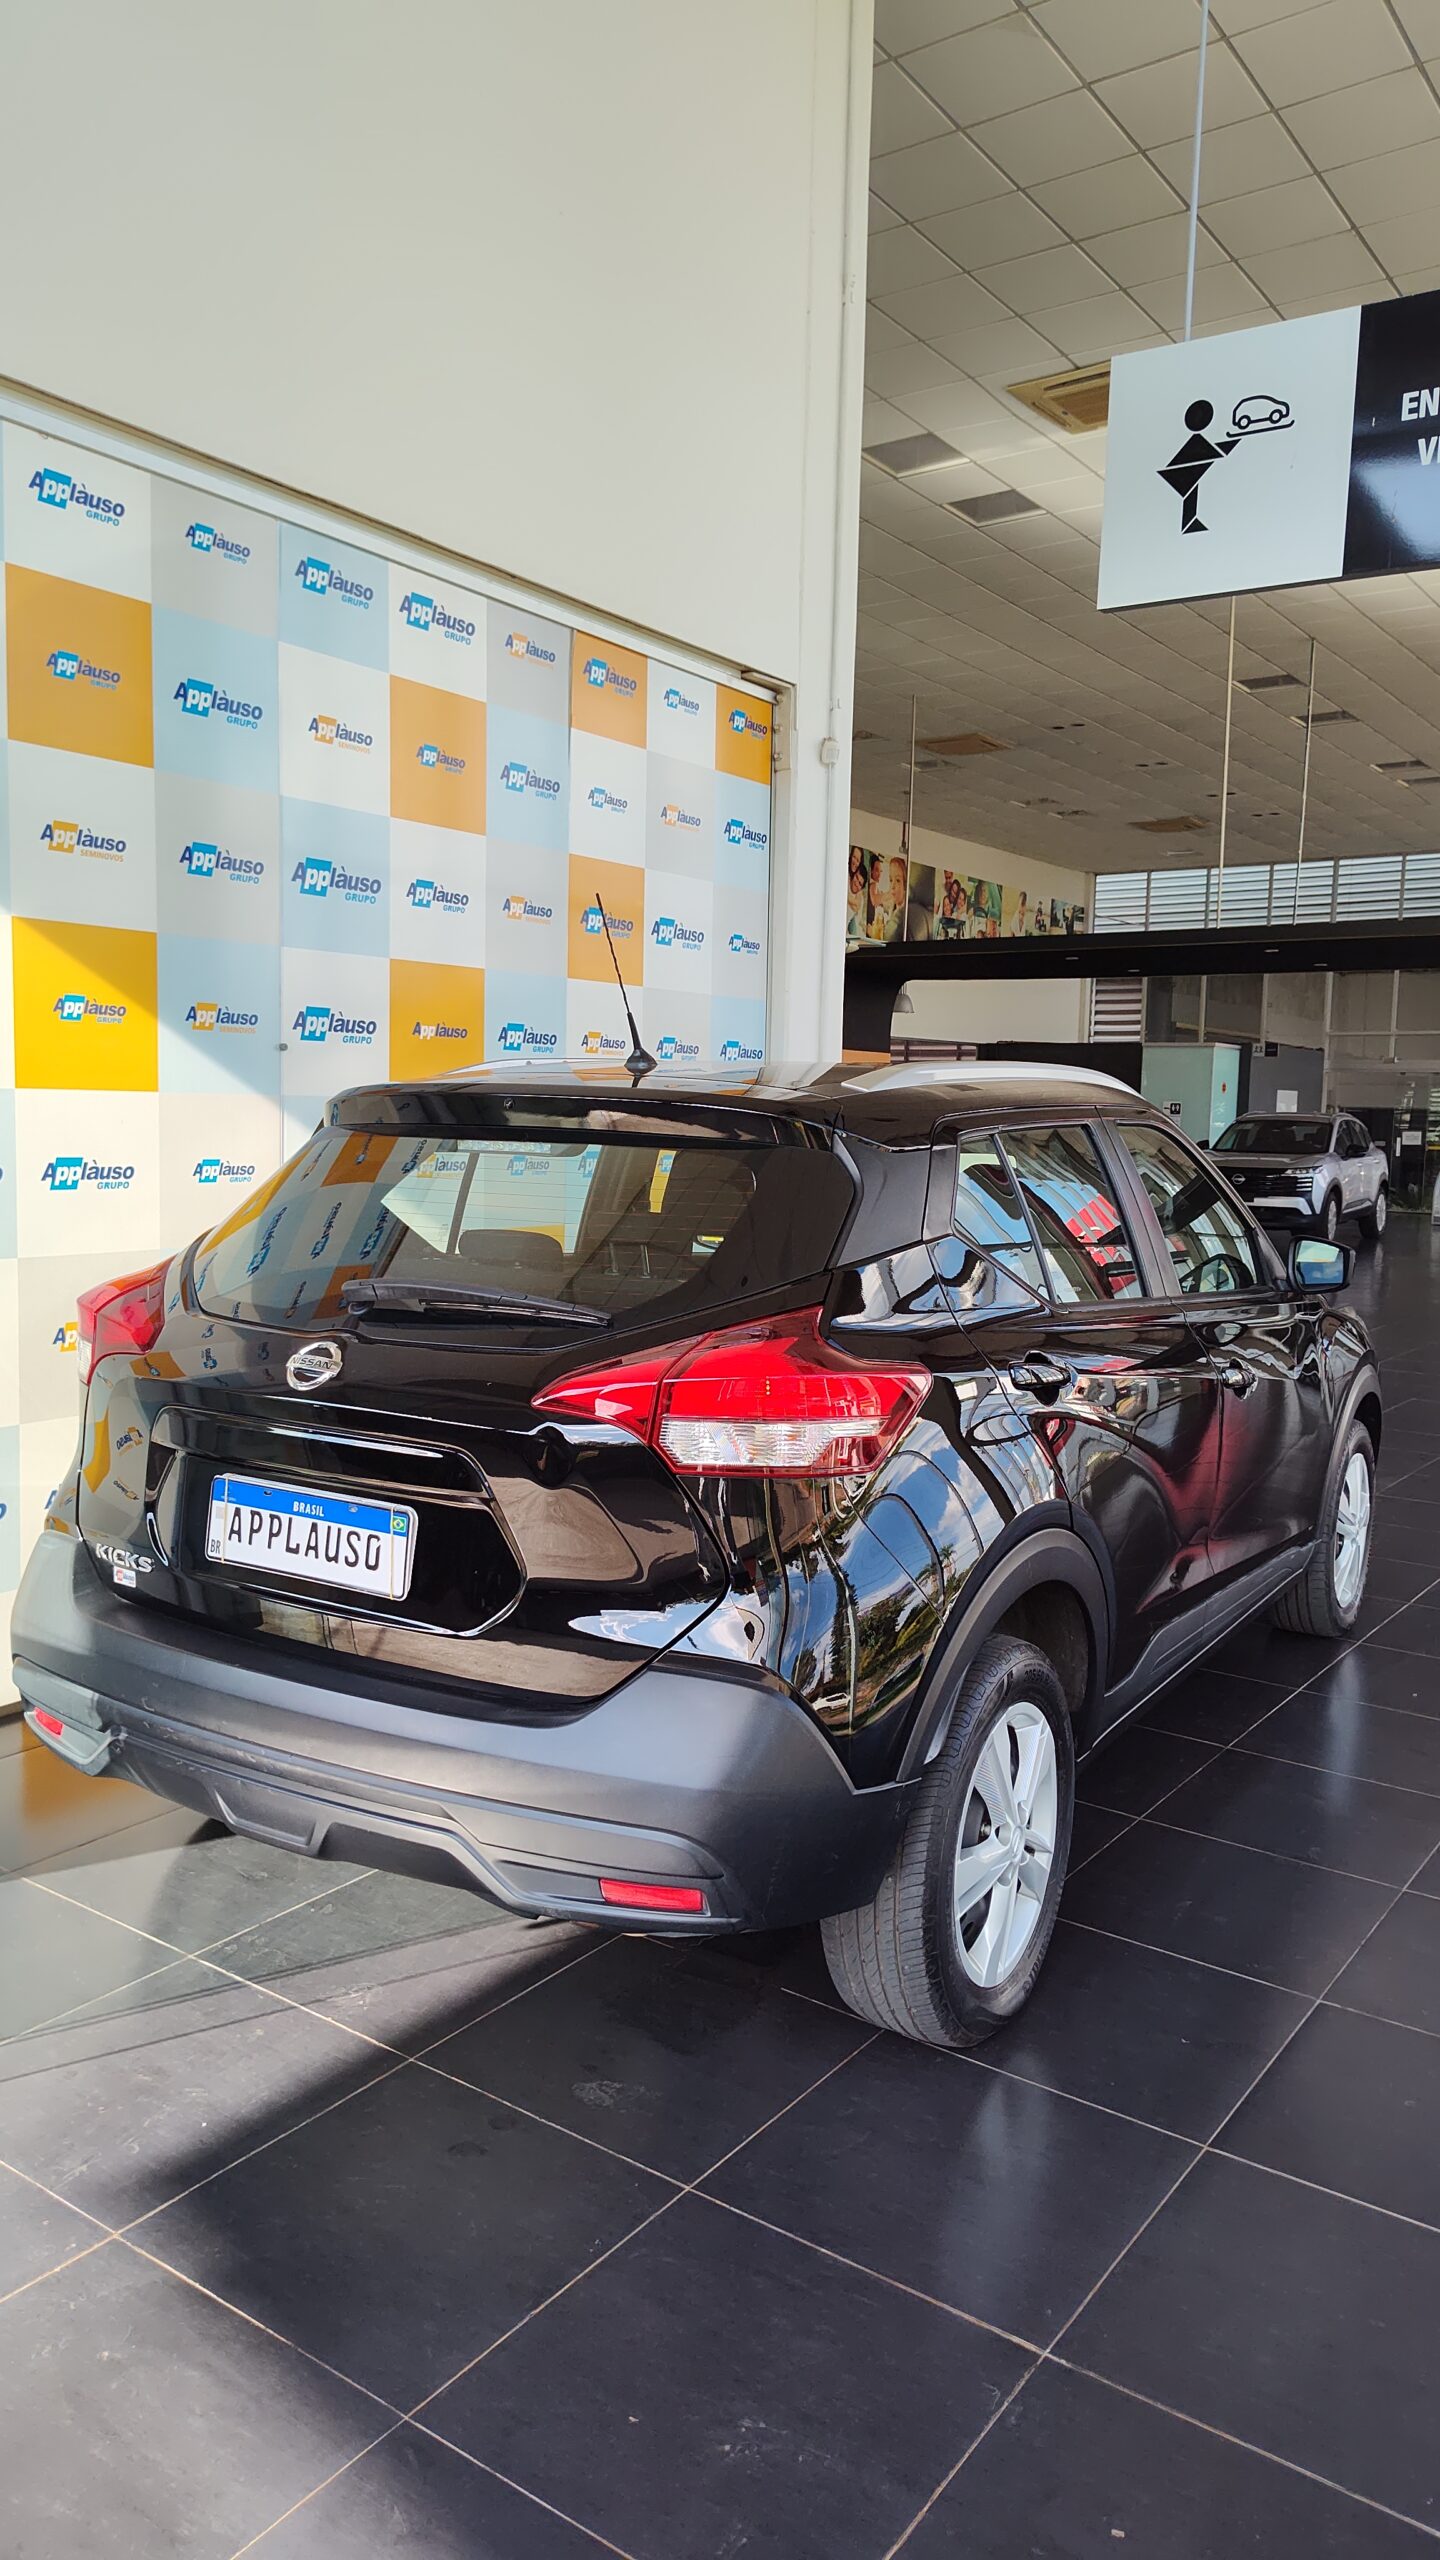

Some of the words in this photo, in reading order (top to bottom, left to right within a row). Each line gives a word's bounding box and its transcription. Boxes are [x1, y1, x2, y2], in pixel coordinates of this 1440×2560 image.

[29, 471, 125, 517] Applàuso
[86, 510, 119, 526] GRUPO
[186, 525, 250, 557] Applàuso
[295, 560, 373, 601] Applàuso
[341, 595, 369, 609] GRUPO
[399, 596, 475, 636] Applàuso
[444, 631, 471, 645] GRUPO
[505, 635, 556, 662] Applàuso
[47, 653, 120, 683] Applàuso
[583, 661, 637, 691] Applàuso
[174, 683, 263, 720] Applàuso
[664, 691, 699, 711] Applàuso
[227, 716, 258, 729] GRUPO
[308, 717, 373, 746] Applàuso
[729, 712, 767, 735] Applàuso
[416, 746, 465, 768] Applàuso
[500, 765, 560, 793] Applàuso
[536, 790, 557, 800] GRUPO
[588, 789, 627, 808] Applàuso
[40, 823, 126, 852] Applàuso
[724, 821, 767, 844] Applàuso
[80, 849, 123, 862] SEMINOVOS
[180, 846, 264, 875] Applàuso
[230, 874, 259, 884] GRUPO
[292, 861, 381, 894] Applàuso
[345, 893, 376, 904] GRUPO
[406, 882, 469, 906] Applàuso
[443, 905, 465, 913] GRUPO
[502, 898, 552, 918] Applàuso
[651, 920, 704, 943] Applàuso
[53, 998, 126, 1017] Applàuso
[186, 1005, 258, 1026] Applàuso
[293, 1010, 376, 1035] Applàuso
[412, 1022, 467, 1039] Applàuso
[342, 1035, 372, 1044] GRUPO
[498, 1025, 557, 1047] Applàuso
[533, 1045, 554, 1053] GRUPO
[41, 1159, 134, 1186] Applàuso
[192, 1159, 256, 1180] Applàuso
[97, 1180, 129, 1189] GRUPO
[291, 1357, 333, 1369] NISSAN
[293, 1501, 324, 1517] BRASIL
[210, 1539, 221, 1554] BR
[228, 1507, 381, 1571] APPLAUSO
[96, 1543, 153, 1573] KICKS
